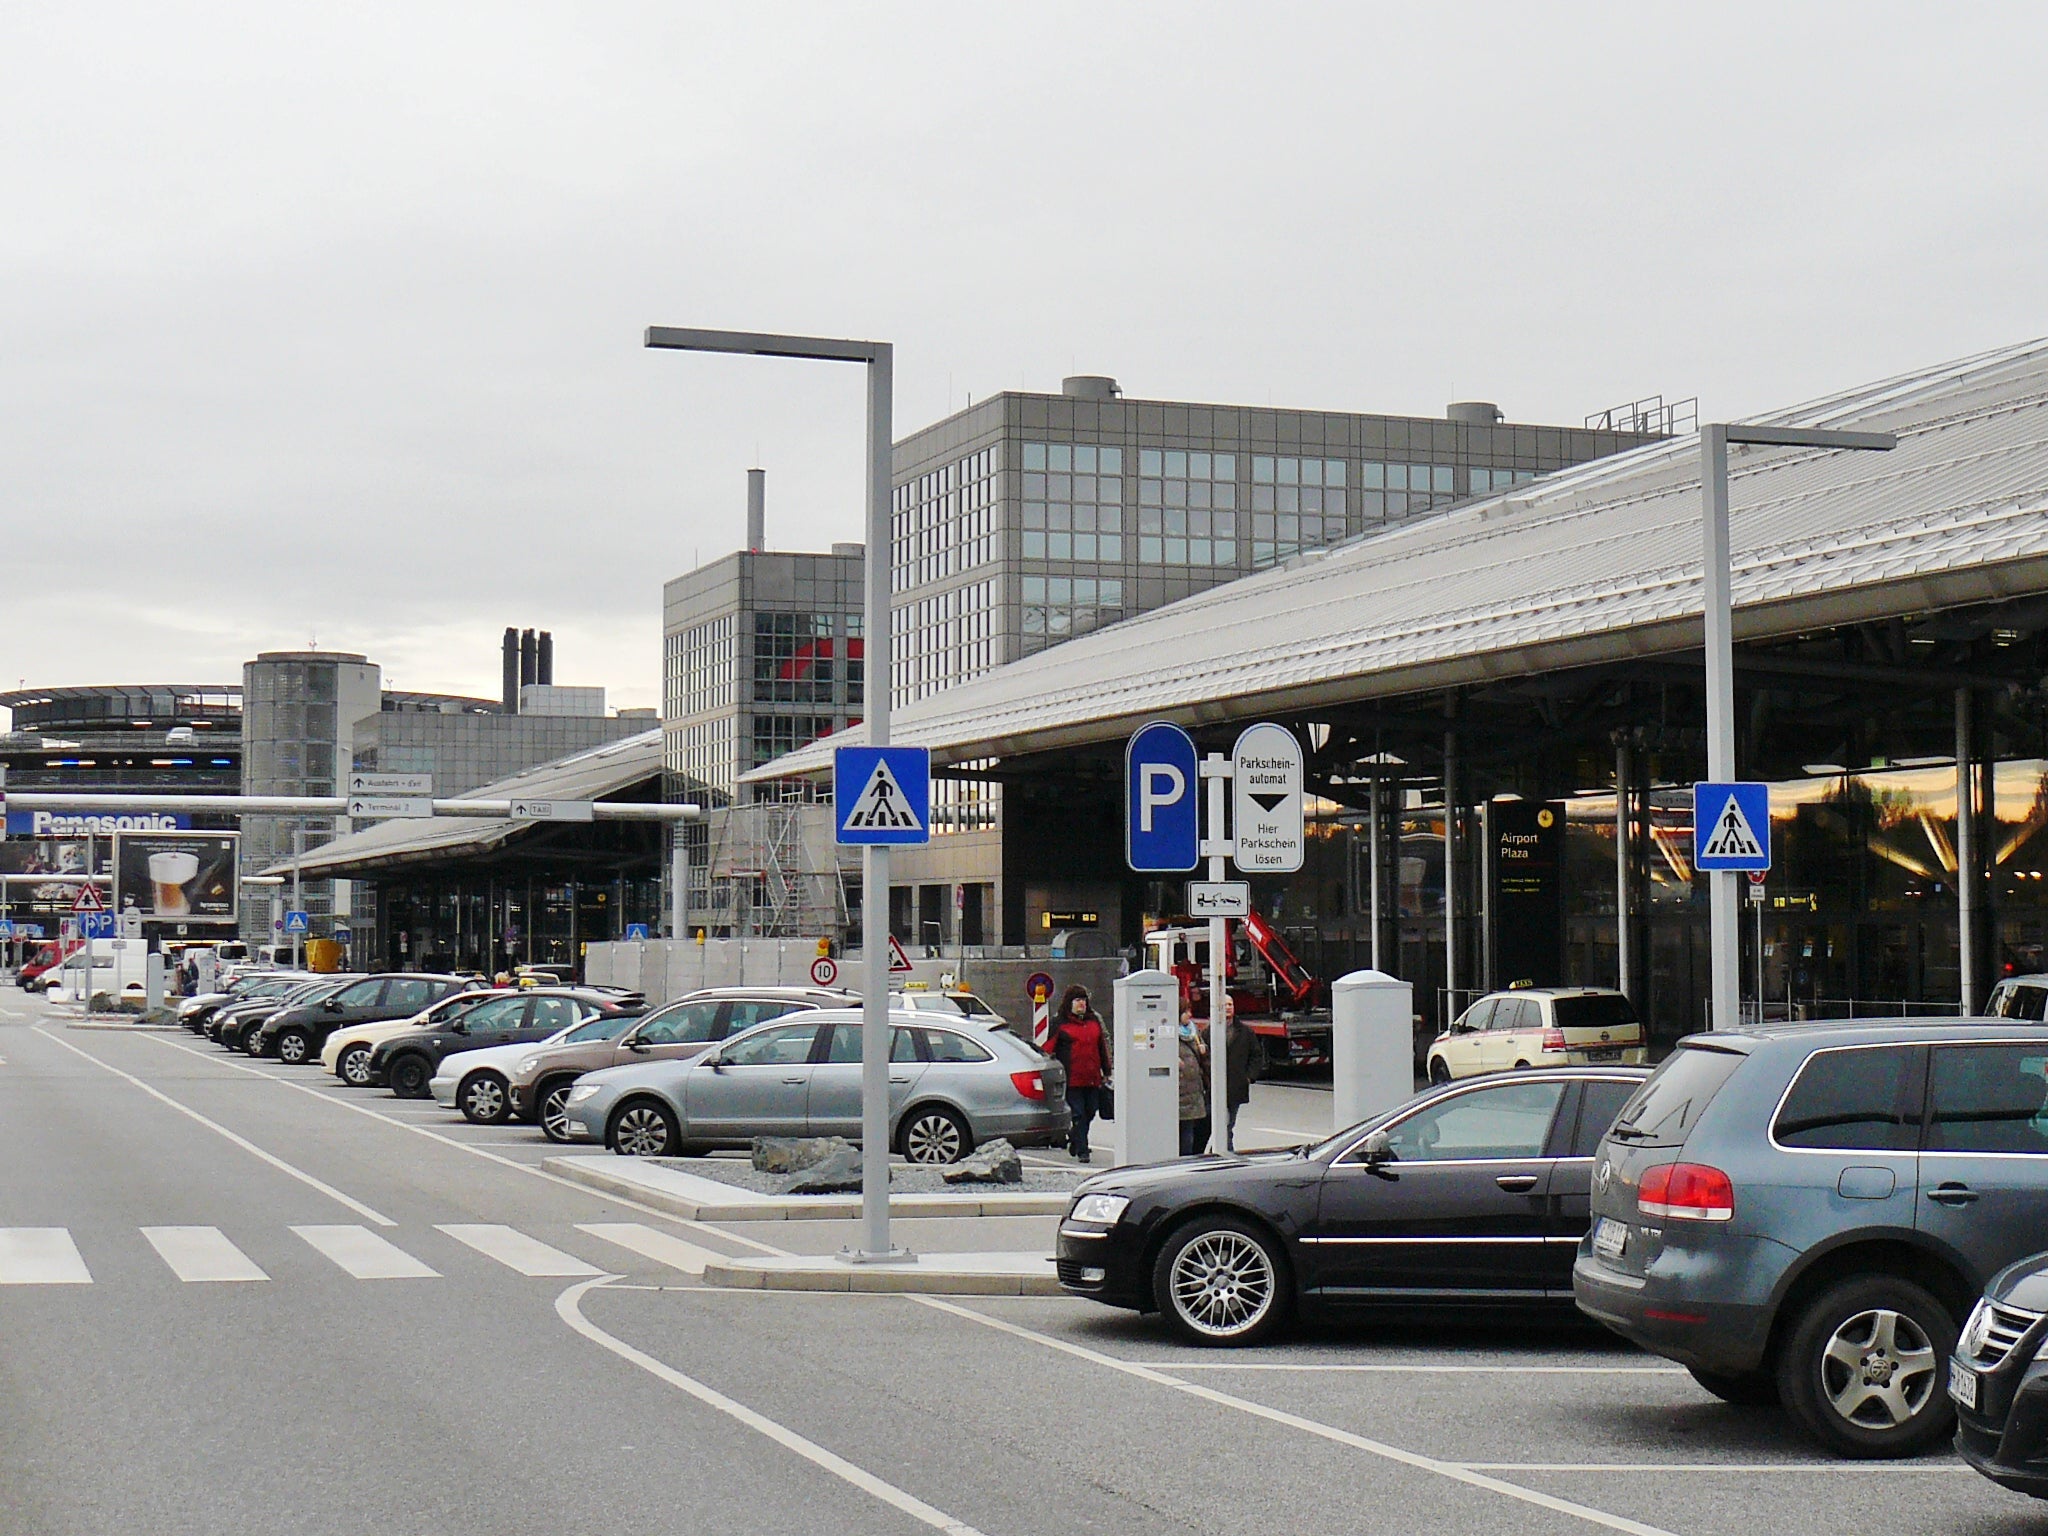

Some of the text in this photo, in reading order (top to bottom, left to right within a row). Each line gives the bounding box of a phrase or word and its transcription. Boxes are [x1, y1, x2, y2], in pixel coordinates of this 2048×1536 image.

[1240, 757, 1296, 769] Parkschein-
[1249, 773, 1287, 785] automat
[1140, 763, 1185, 831] P
[33, 811, 177, 834] Panasonic
[1257, 823, 1279, 834] Hier
[1241, 838, 1297, 849] Parkschein
[1501, 832, 1538, 845] Airport
[1255, 853, 1283, 864] lösen
[1501, 847, 1529, 858] Plaza
[101, 915, 113, 931] P
[818, 965, 831, 978] 10
